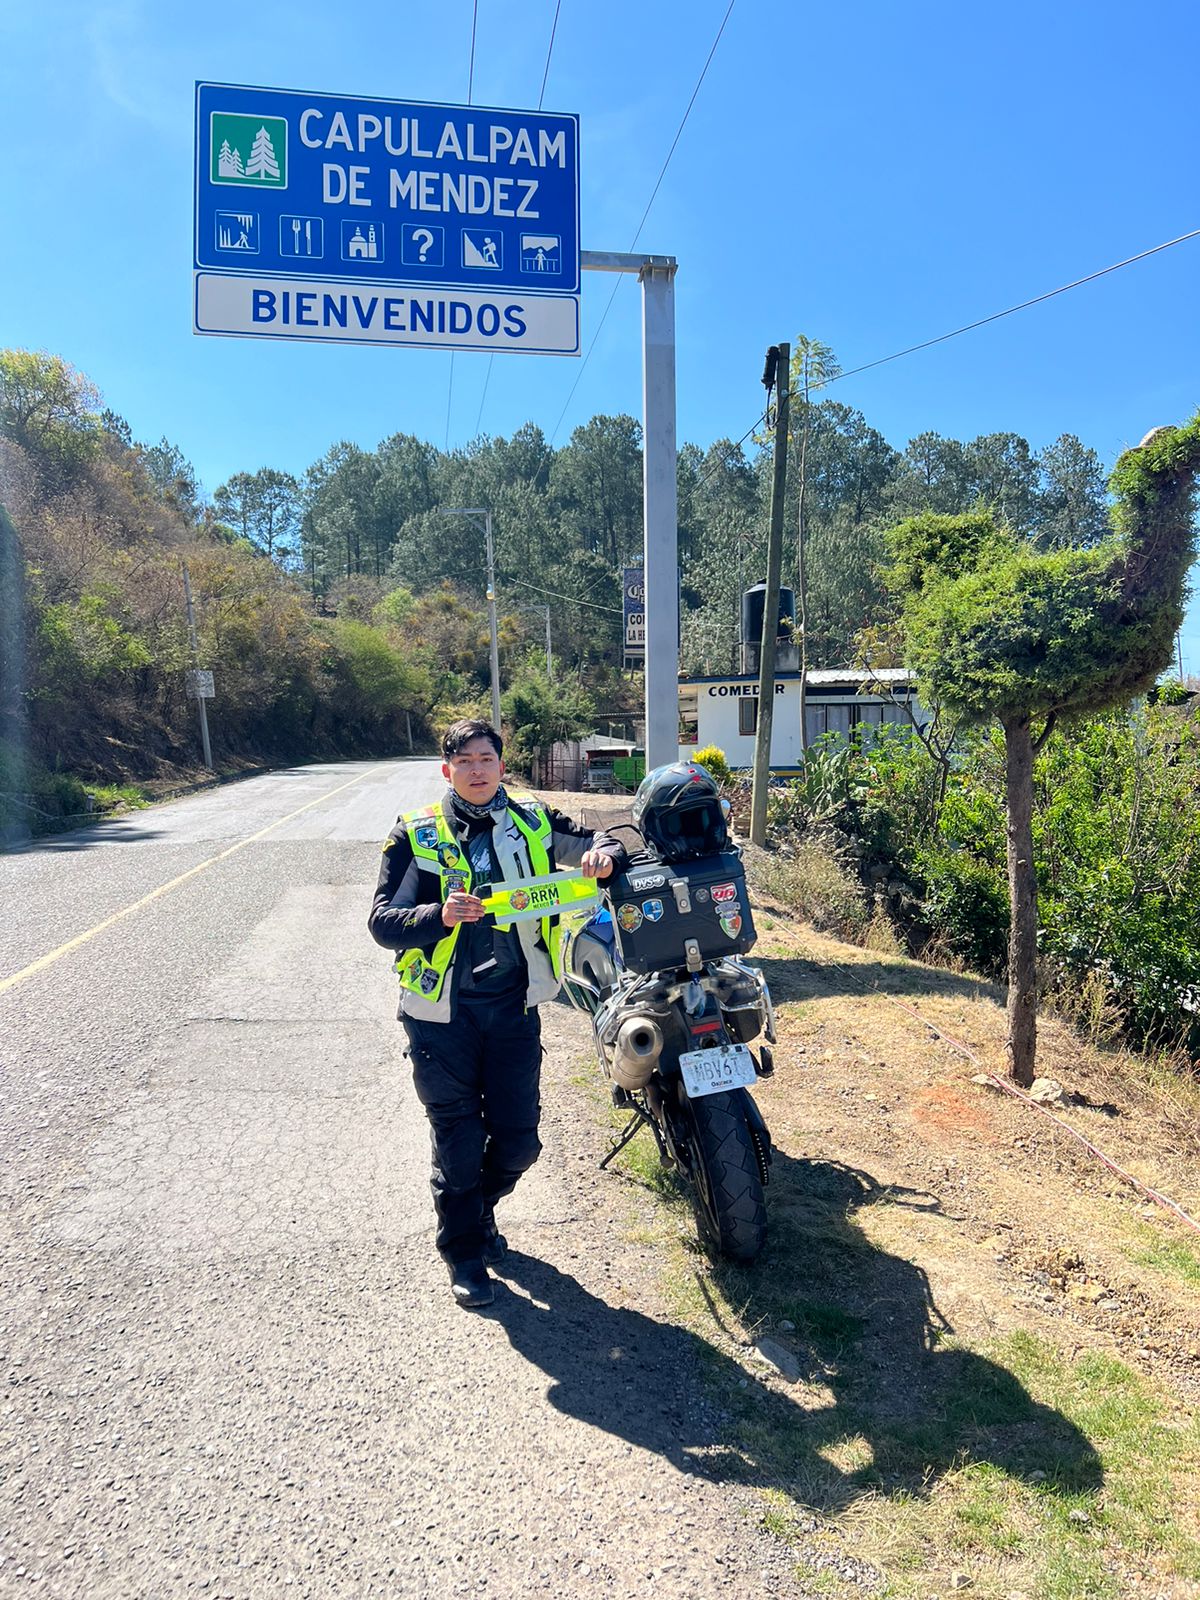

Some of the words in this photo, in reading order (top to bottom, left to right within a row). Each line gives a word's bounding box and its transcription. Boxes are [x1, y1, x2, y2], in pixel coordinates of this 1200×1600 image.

[299, 108, 566, 168] CAPULALPAM
[322, 163, 372, 207] DE
[389, 168, 540, 219] MENDEZ
[252, 289, 527, 338] BIENVENIDOS
[708, 684, 785, 697] COMEDR
[531, 887, 559, 904] RRM
